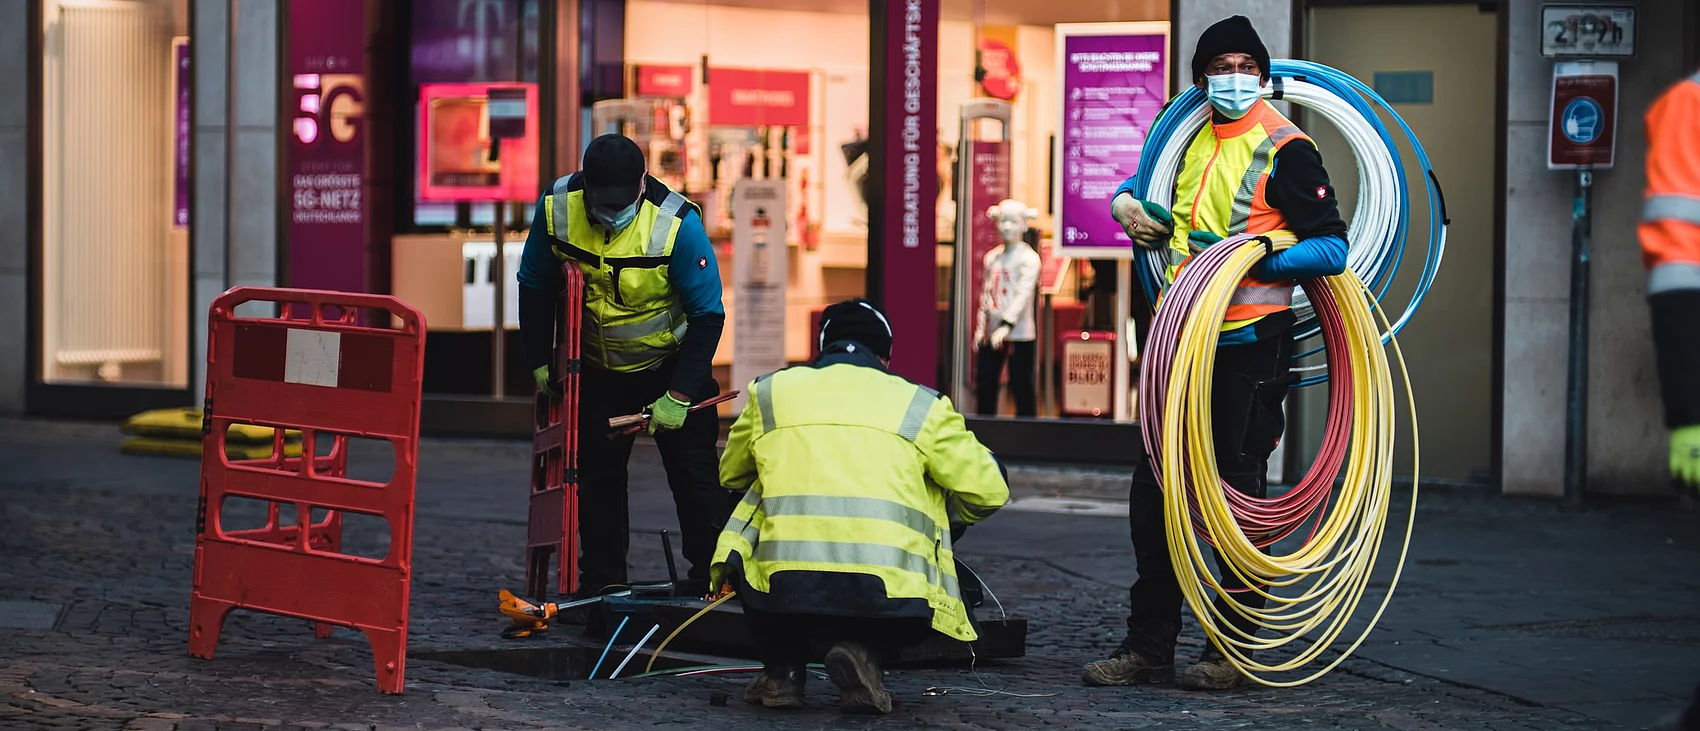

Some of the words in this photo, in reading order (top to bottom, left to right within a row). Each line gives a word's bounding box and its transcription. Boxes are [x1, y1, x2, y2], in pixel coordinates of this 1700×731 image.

[293, 73, 364, 145] 5G
[902, 115, 921, 152] FÜR
[294, 174, 314, 189] DAS
[294, 189, 361, 210] 5G-NETZ
[903, 153, 920, 248] BERATUNG
